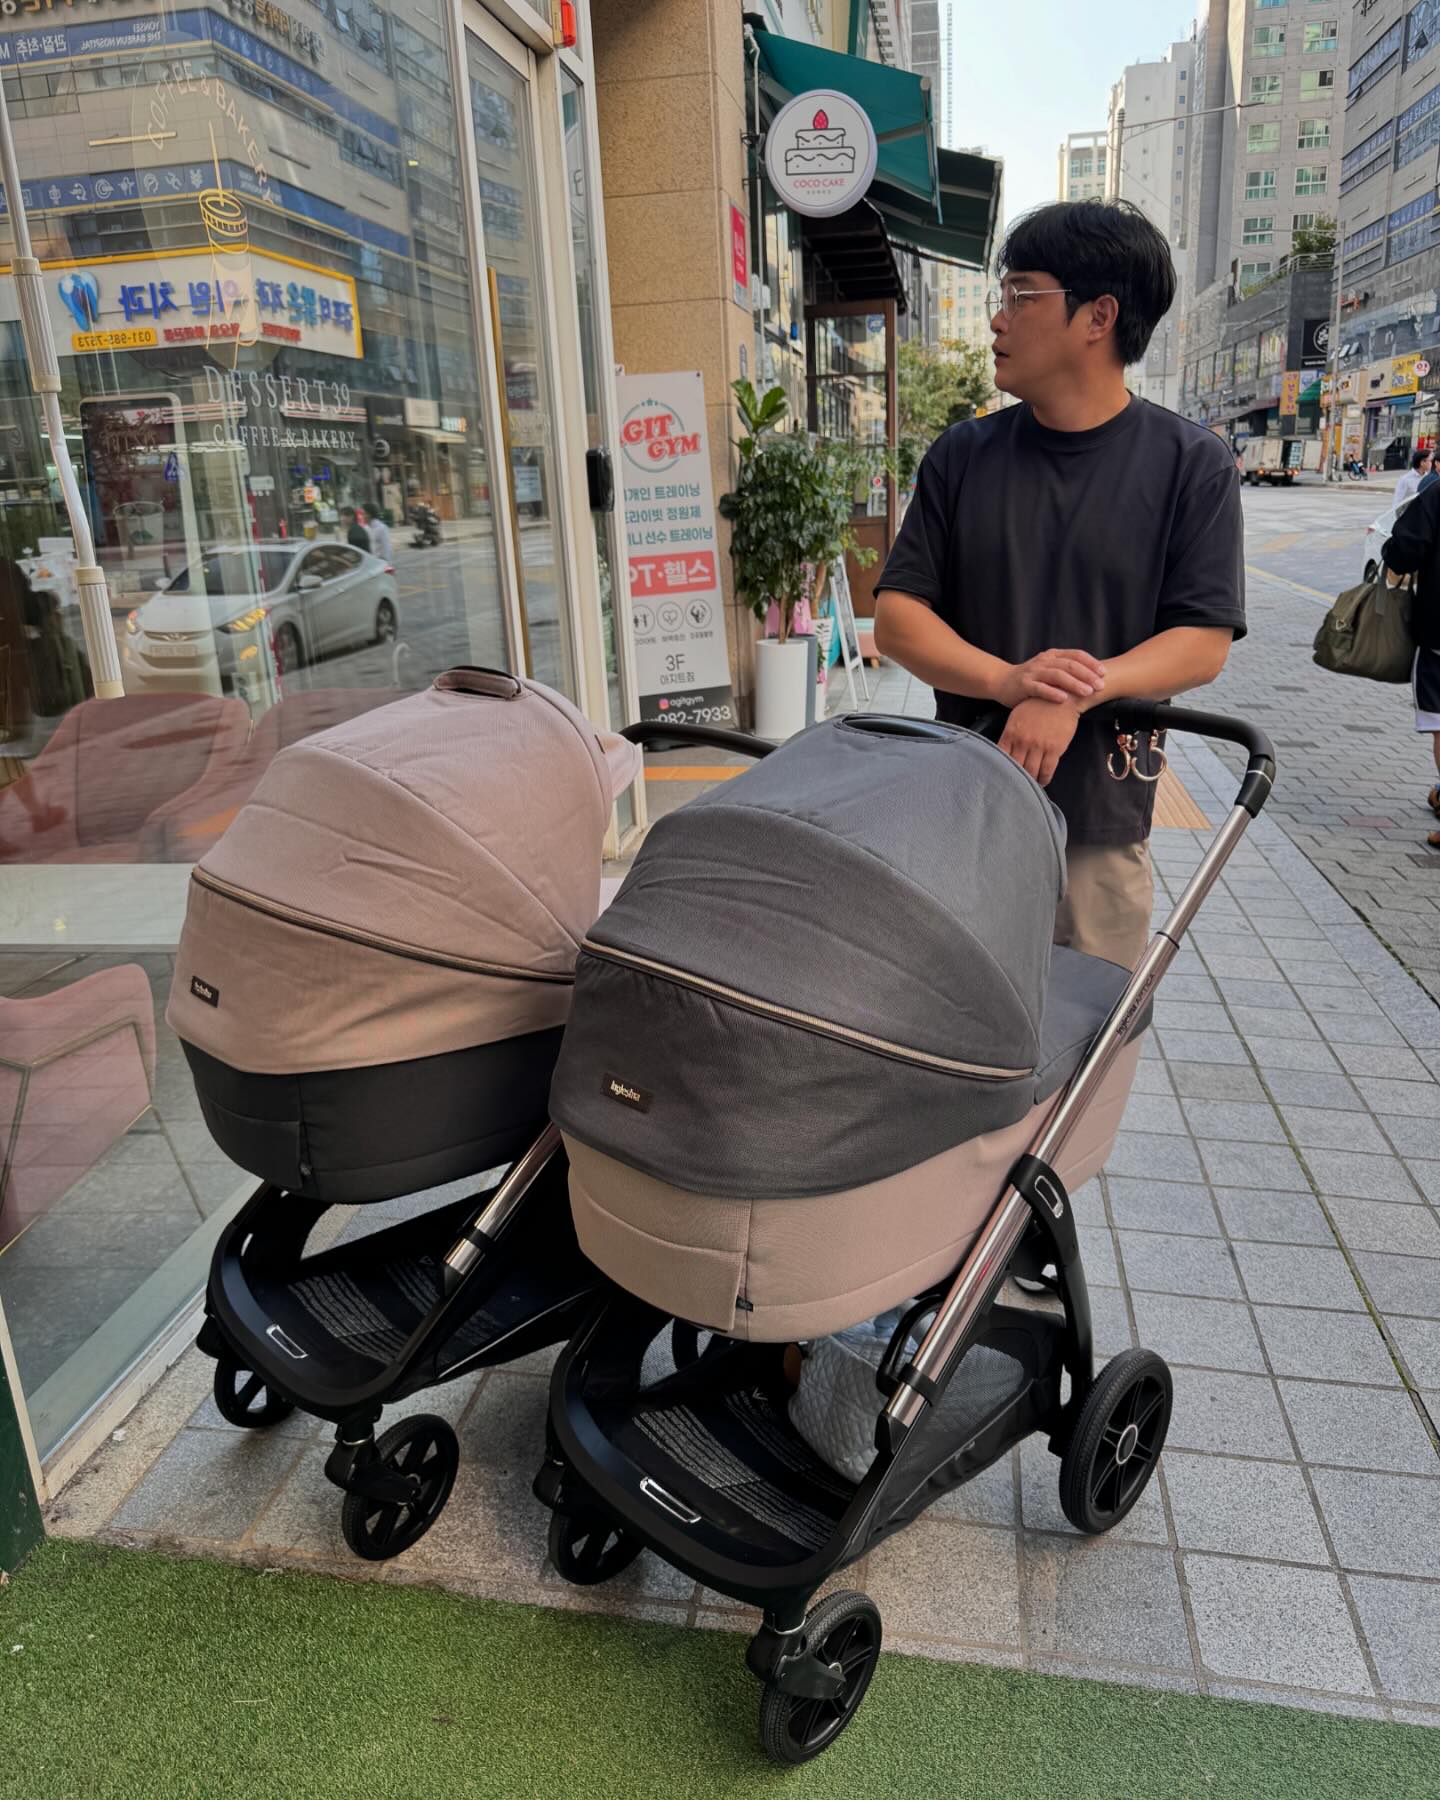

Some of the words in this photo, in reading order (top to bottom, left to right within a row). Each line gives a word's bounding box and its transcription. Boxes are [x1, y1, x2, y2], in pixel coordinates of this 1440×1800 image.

[147, 61, 197, 151] COFFEE
[200, 72, 211, 97] &
[216, 78, 274, 205] BAKERY
[793, 180, 820, 188] COCO
[284, 427, 298, 447] &
[303, 430, 357, 449] BAKERY
[620, 413, 673, 446] GIT
[648, 432, 700, 460] GYM
[655, 482, 701, 500] 트레이닝
[625, 508, 664, 524] 라이빗
[645, 530, 668, 545] 선수
[669, 526, 714, 542] 트레이닝
[665, 654, 685, 672] 3F
[669, 695, 705, 708] agitgym
